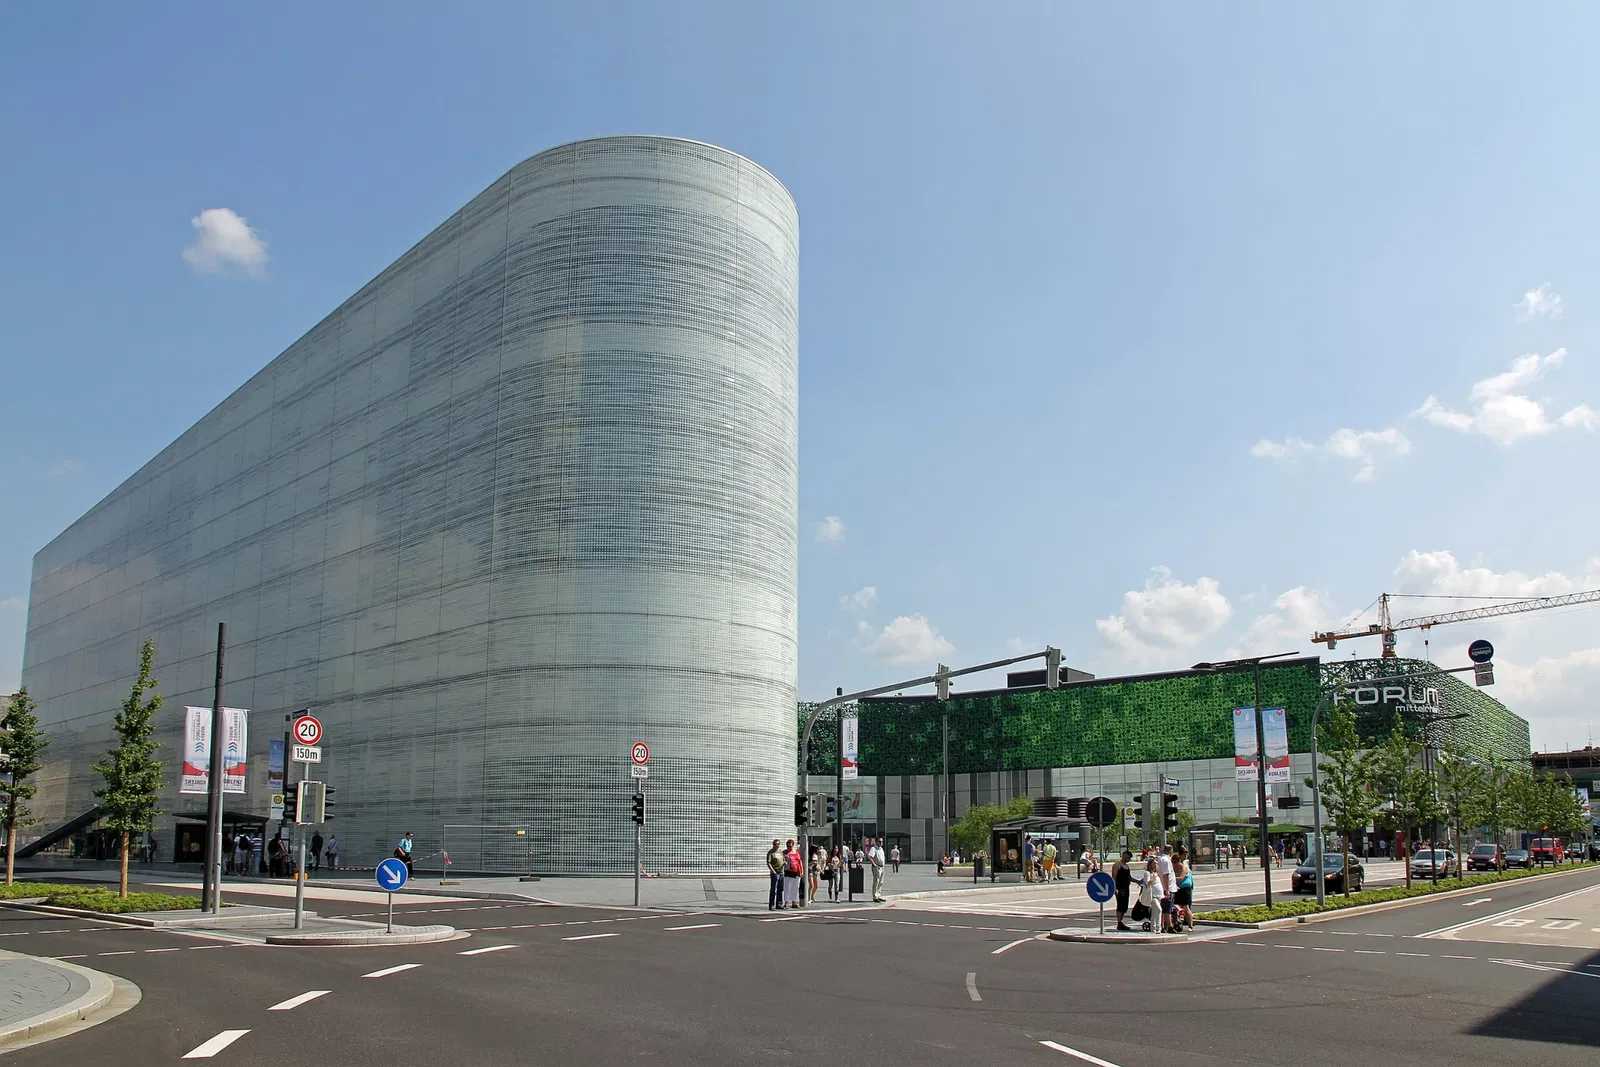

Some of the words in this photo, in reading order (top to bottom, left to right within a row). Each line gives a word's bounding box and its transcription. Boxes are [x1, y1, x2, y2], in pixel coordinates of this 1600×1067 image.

[1333, 686, 1439, 706] FORUM
[300, 723, 316, 737] 20
[296, 747, 318, 760] 150m
[635, 747, 646, 758] 20
[1491, 917, 1600, 933] BU
